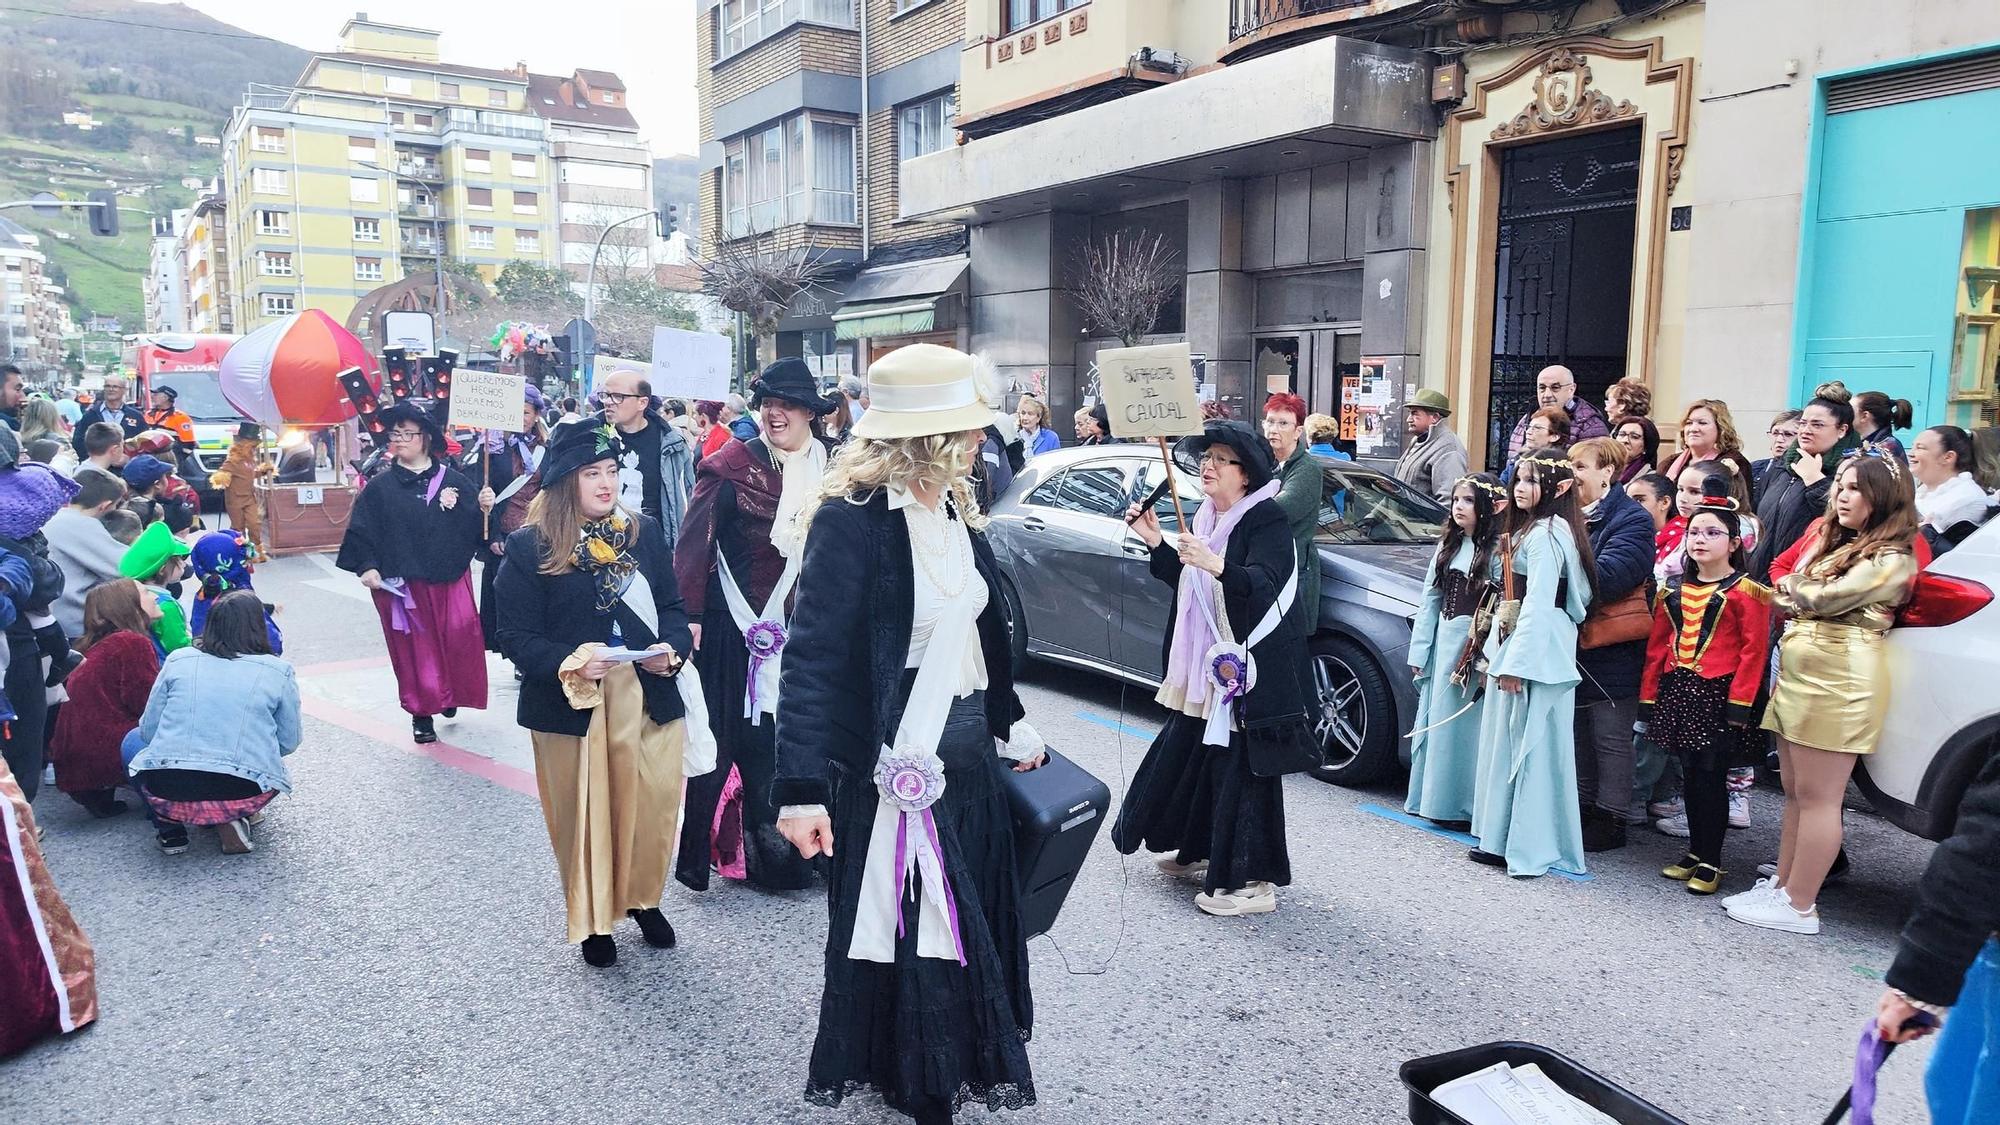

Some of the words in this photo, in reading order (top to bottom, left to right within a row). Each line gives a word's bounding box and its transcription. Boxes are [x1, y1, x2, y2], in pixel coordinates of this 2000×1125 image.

[471, 385, 503, 397] HECHOS
[1126, 402, 1187, 423] CAUDAL
[306, 490, 313, 499] 3
